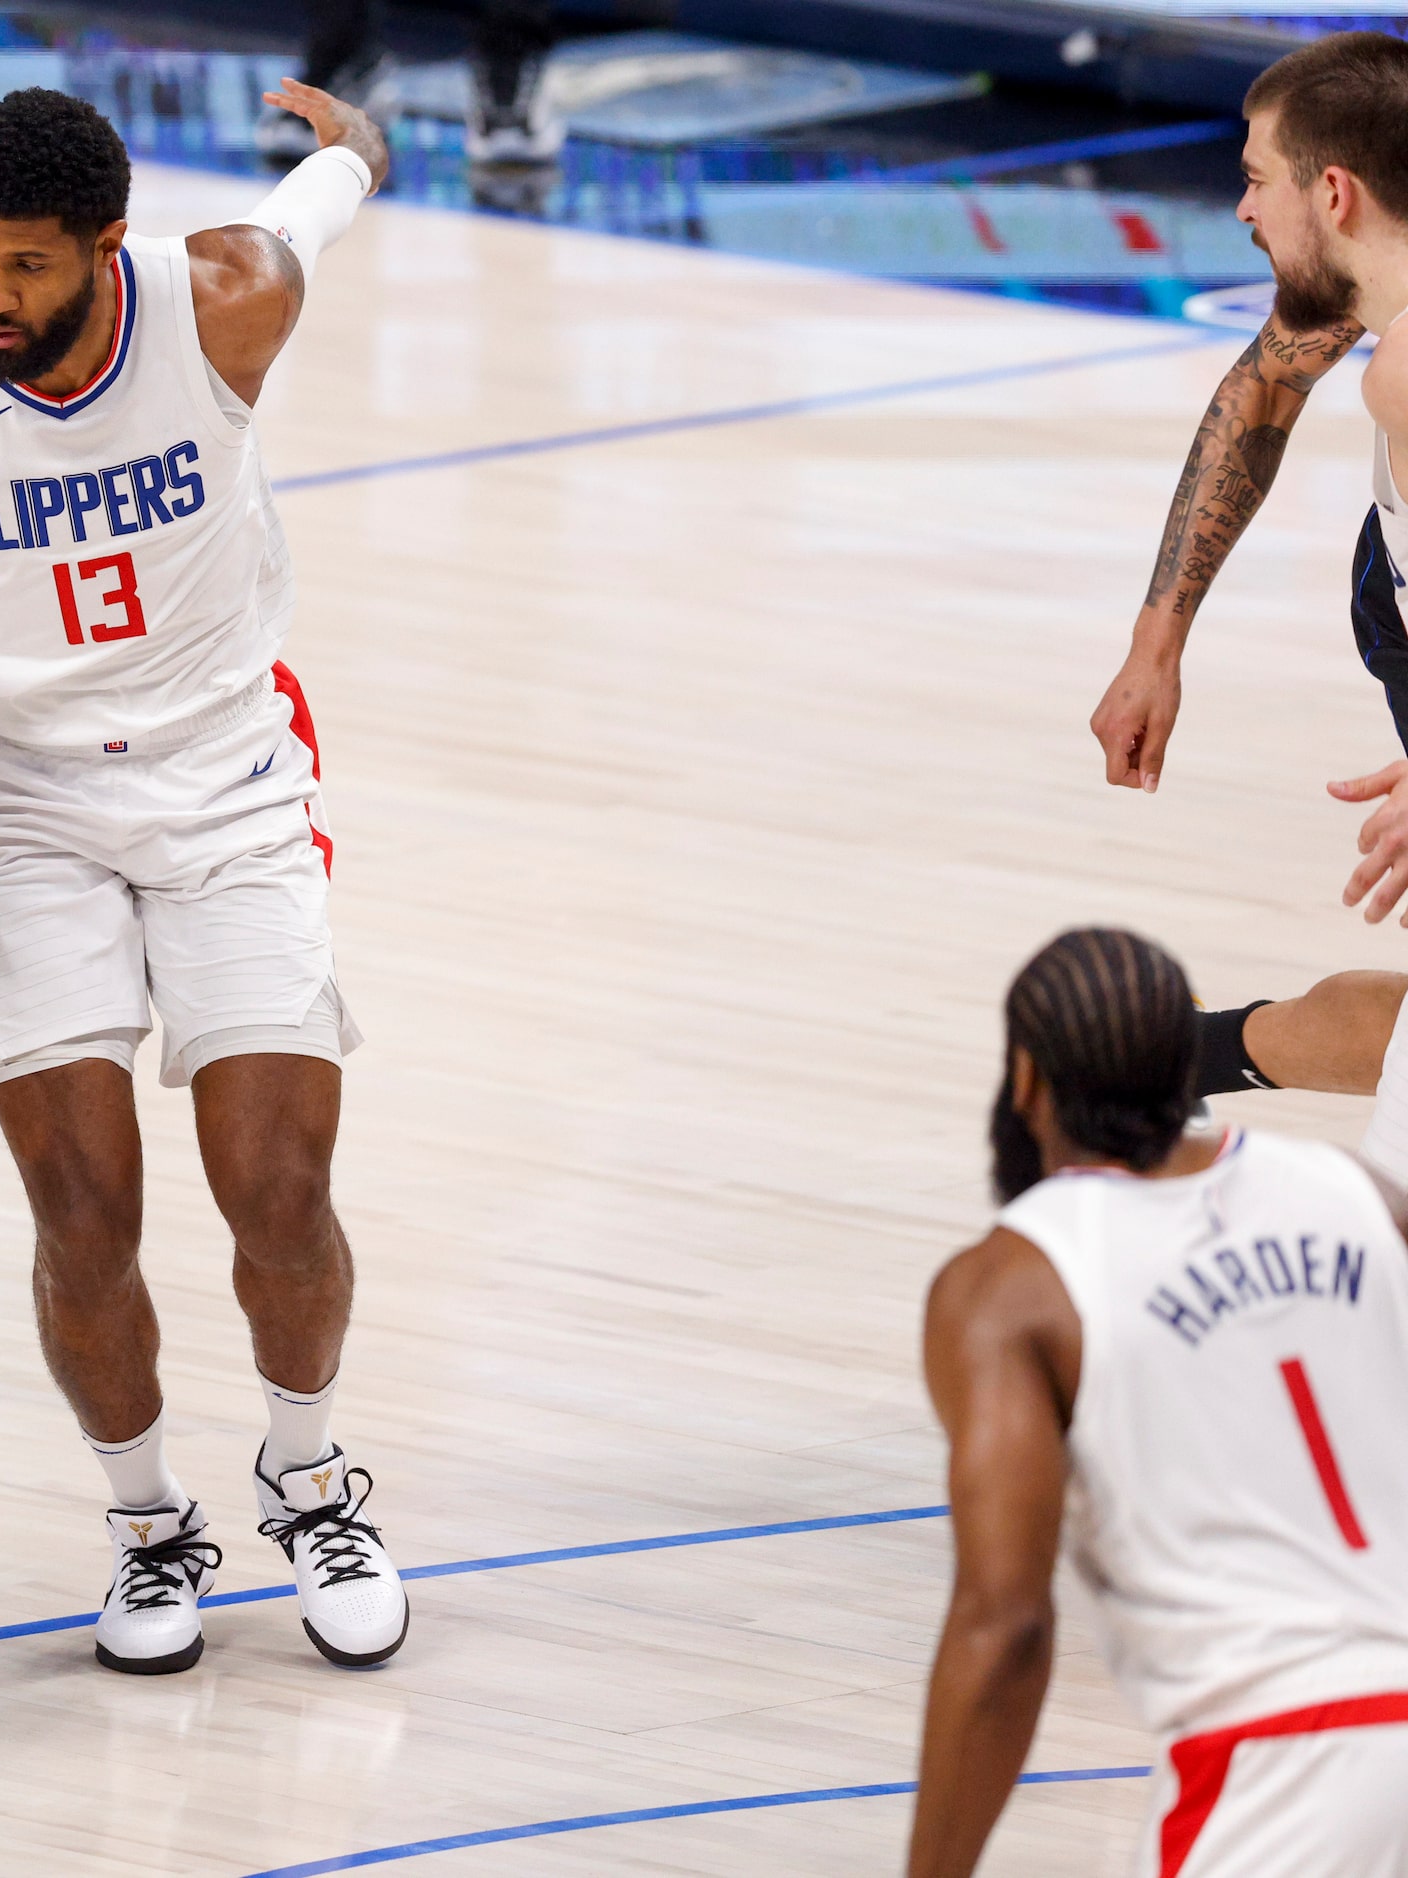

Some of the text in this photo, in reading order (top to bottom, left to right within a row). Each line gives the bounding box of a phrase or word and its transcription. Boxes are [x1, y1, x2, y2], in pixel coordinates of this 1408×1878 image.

[52, 551, 147, 646] 13
[1146, 1234, 1364, 1347] HARDEN
[1279, 1356, 1370, 1551] 1
